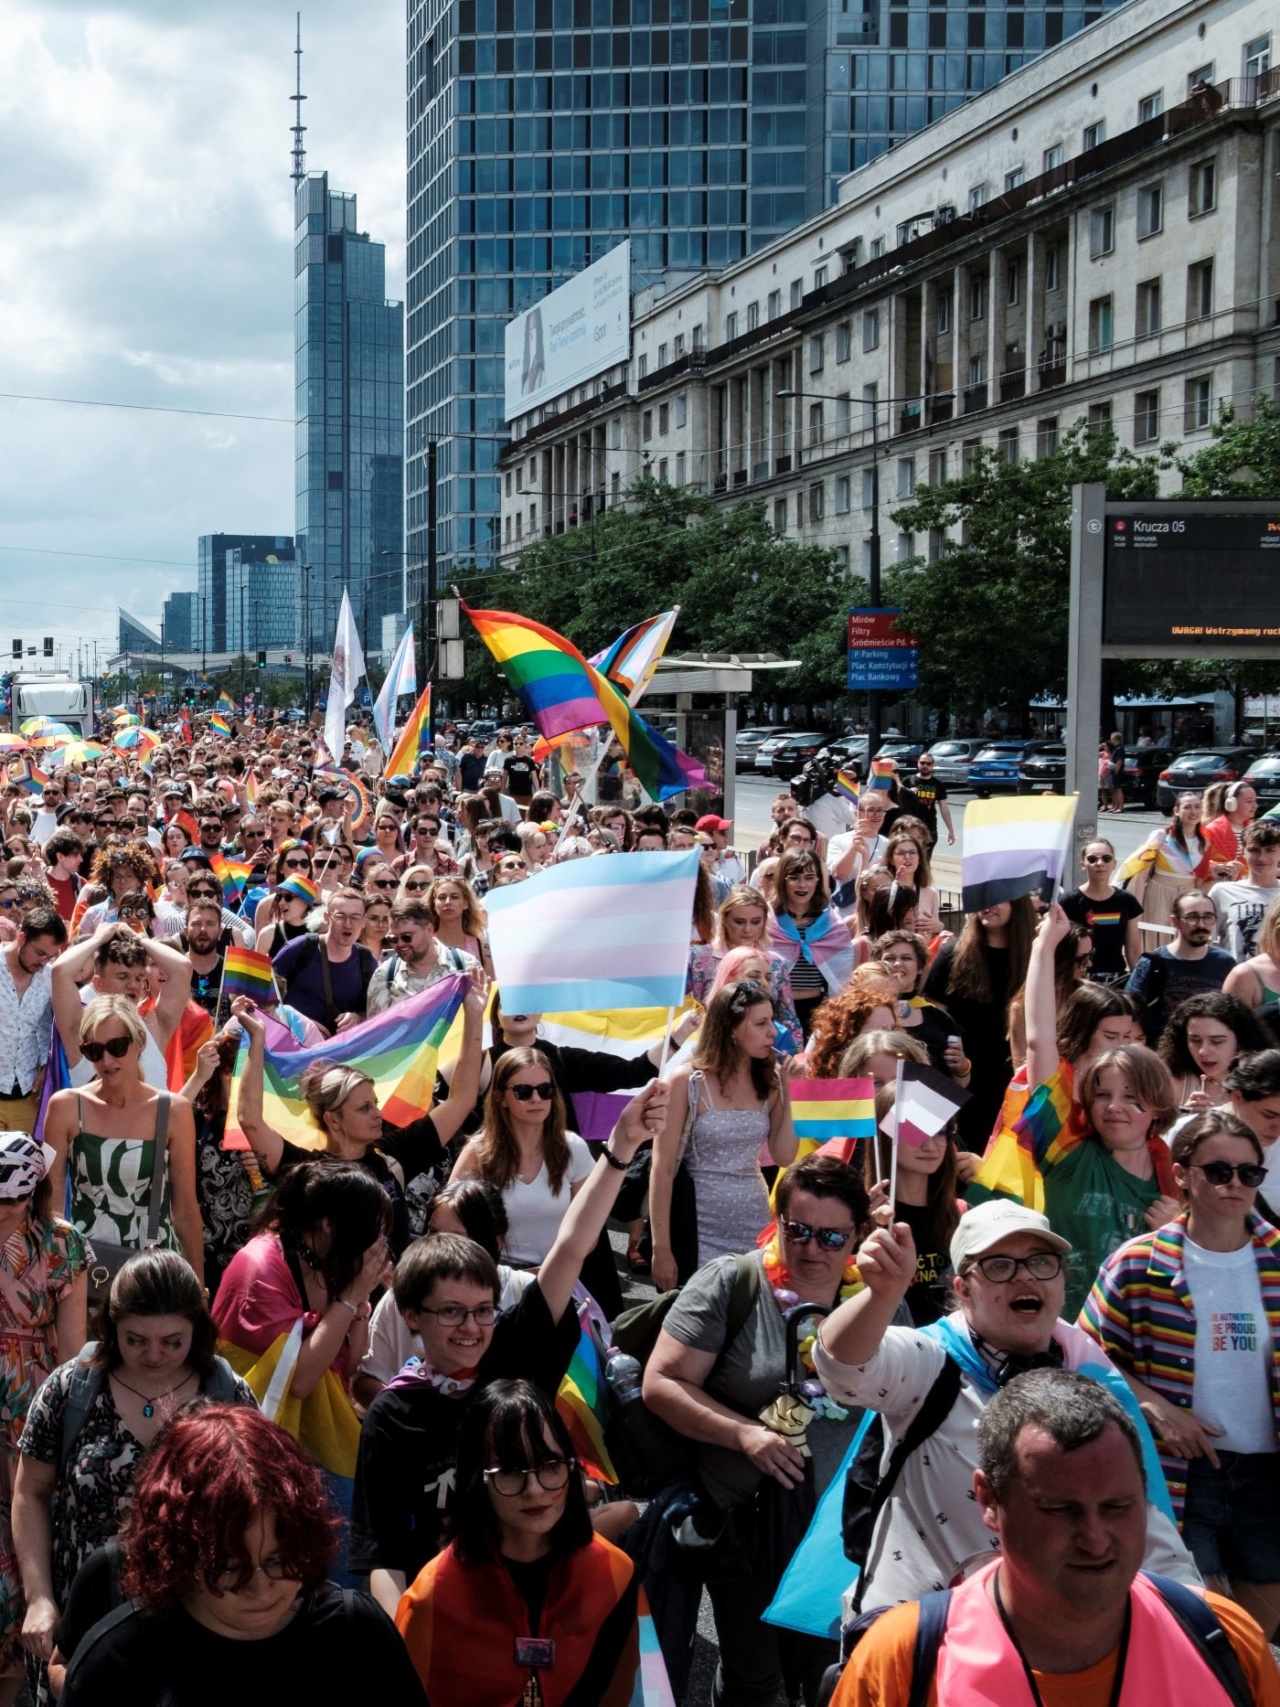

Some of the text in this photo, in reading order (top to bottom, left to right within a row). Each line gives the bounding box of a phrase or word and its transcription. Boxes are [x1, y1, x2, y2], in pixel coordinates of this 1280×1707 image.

[1133, 520, 1185, 533] Krucza 05
[852, 615, 876, 623] Mirów
[851, 627, 871, 637] Filtry
[1171, 626, 1203, 635] UWAGA!
[1205, 626, 1261, 636] Wstrzymany
[851, 638, 908, 646] Śródmieście Pd.
[861, 650, 889, 660] Parking
[868, 662, 908, 671] Konstytucji
[868, 672, 900, 682] Bankowy
[917, 790, 936, 799] IBES
[1211, 1322, 1257, 1335] BE PROUD
[1212, 1335, 1257, 1352] BE YOU
